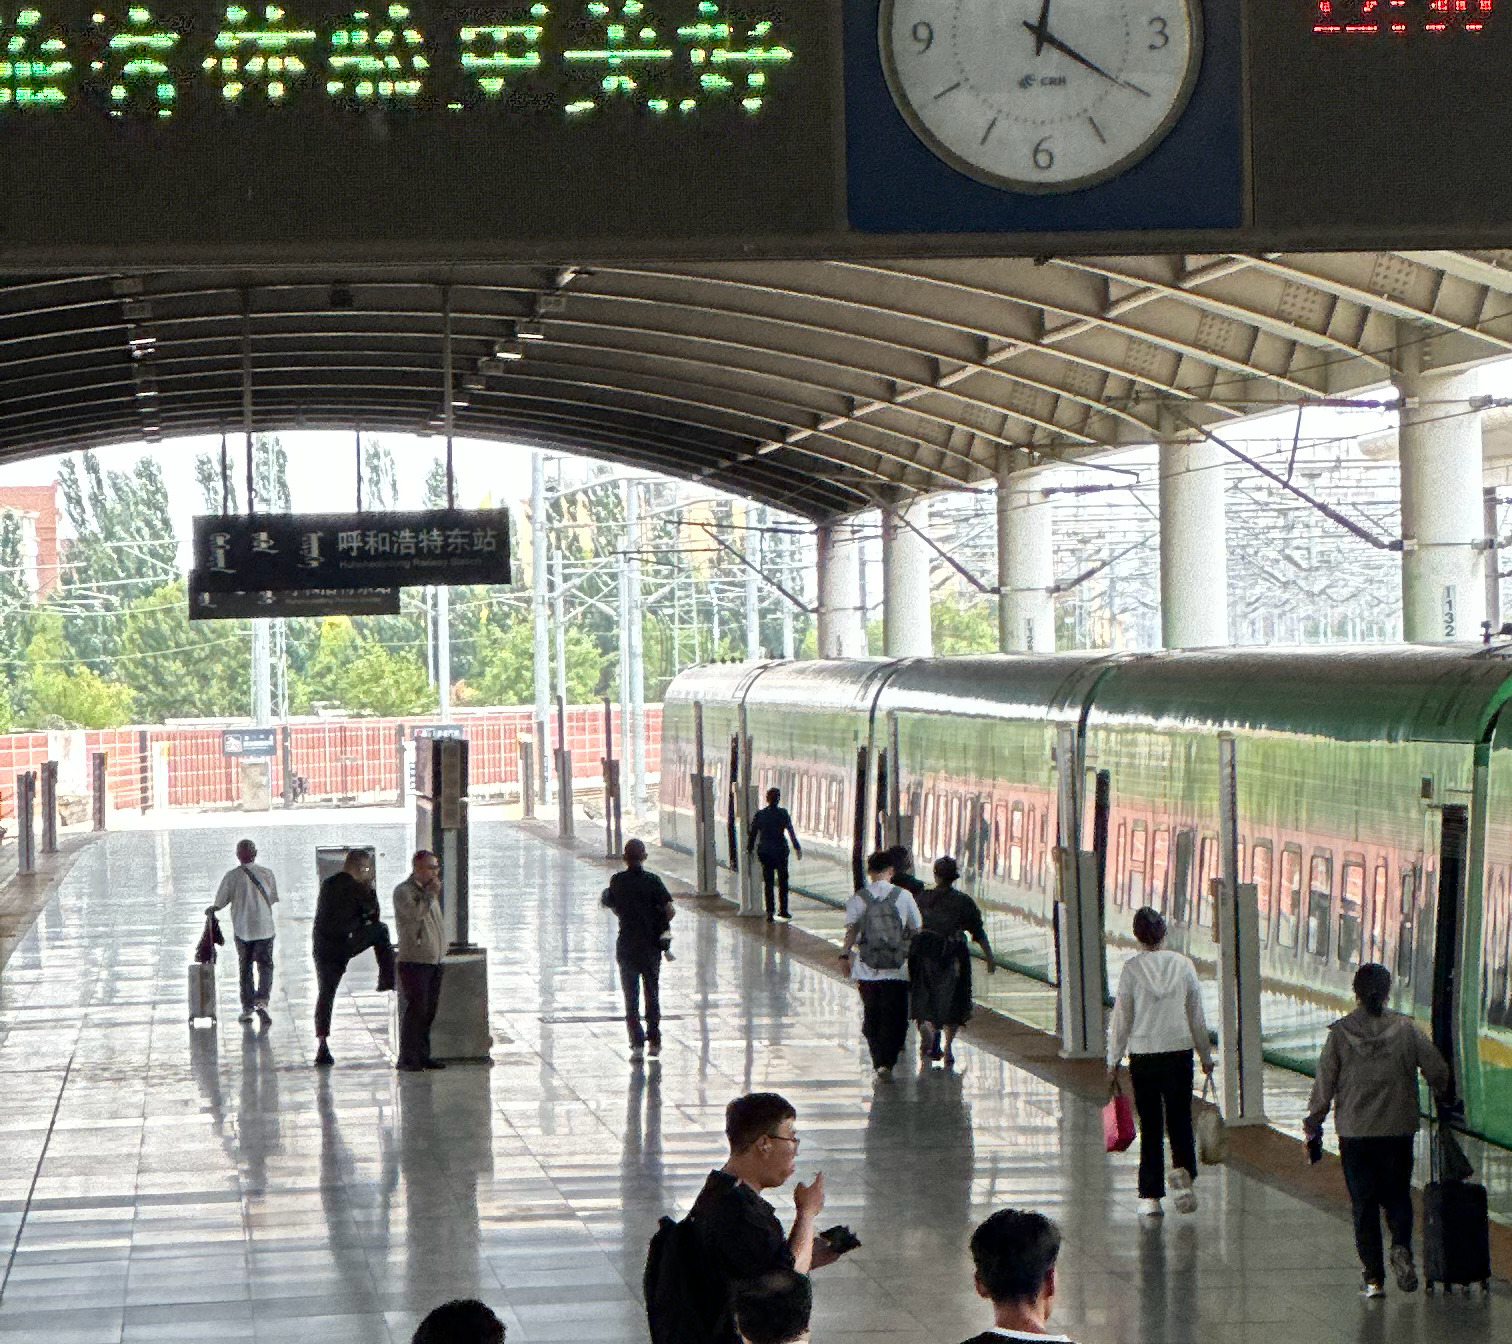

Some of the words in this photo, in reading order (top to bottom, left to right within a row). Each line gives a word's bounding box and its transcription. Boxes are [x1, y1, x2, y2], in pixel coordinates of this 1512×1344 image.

[911, 21, 935, 55] 9
[1147, 16, 1170, 50] 3
[1032, 136, 1055, 170] 6
[337, 527, 498, 557] 呼和浩特东站
